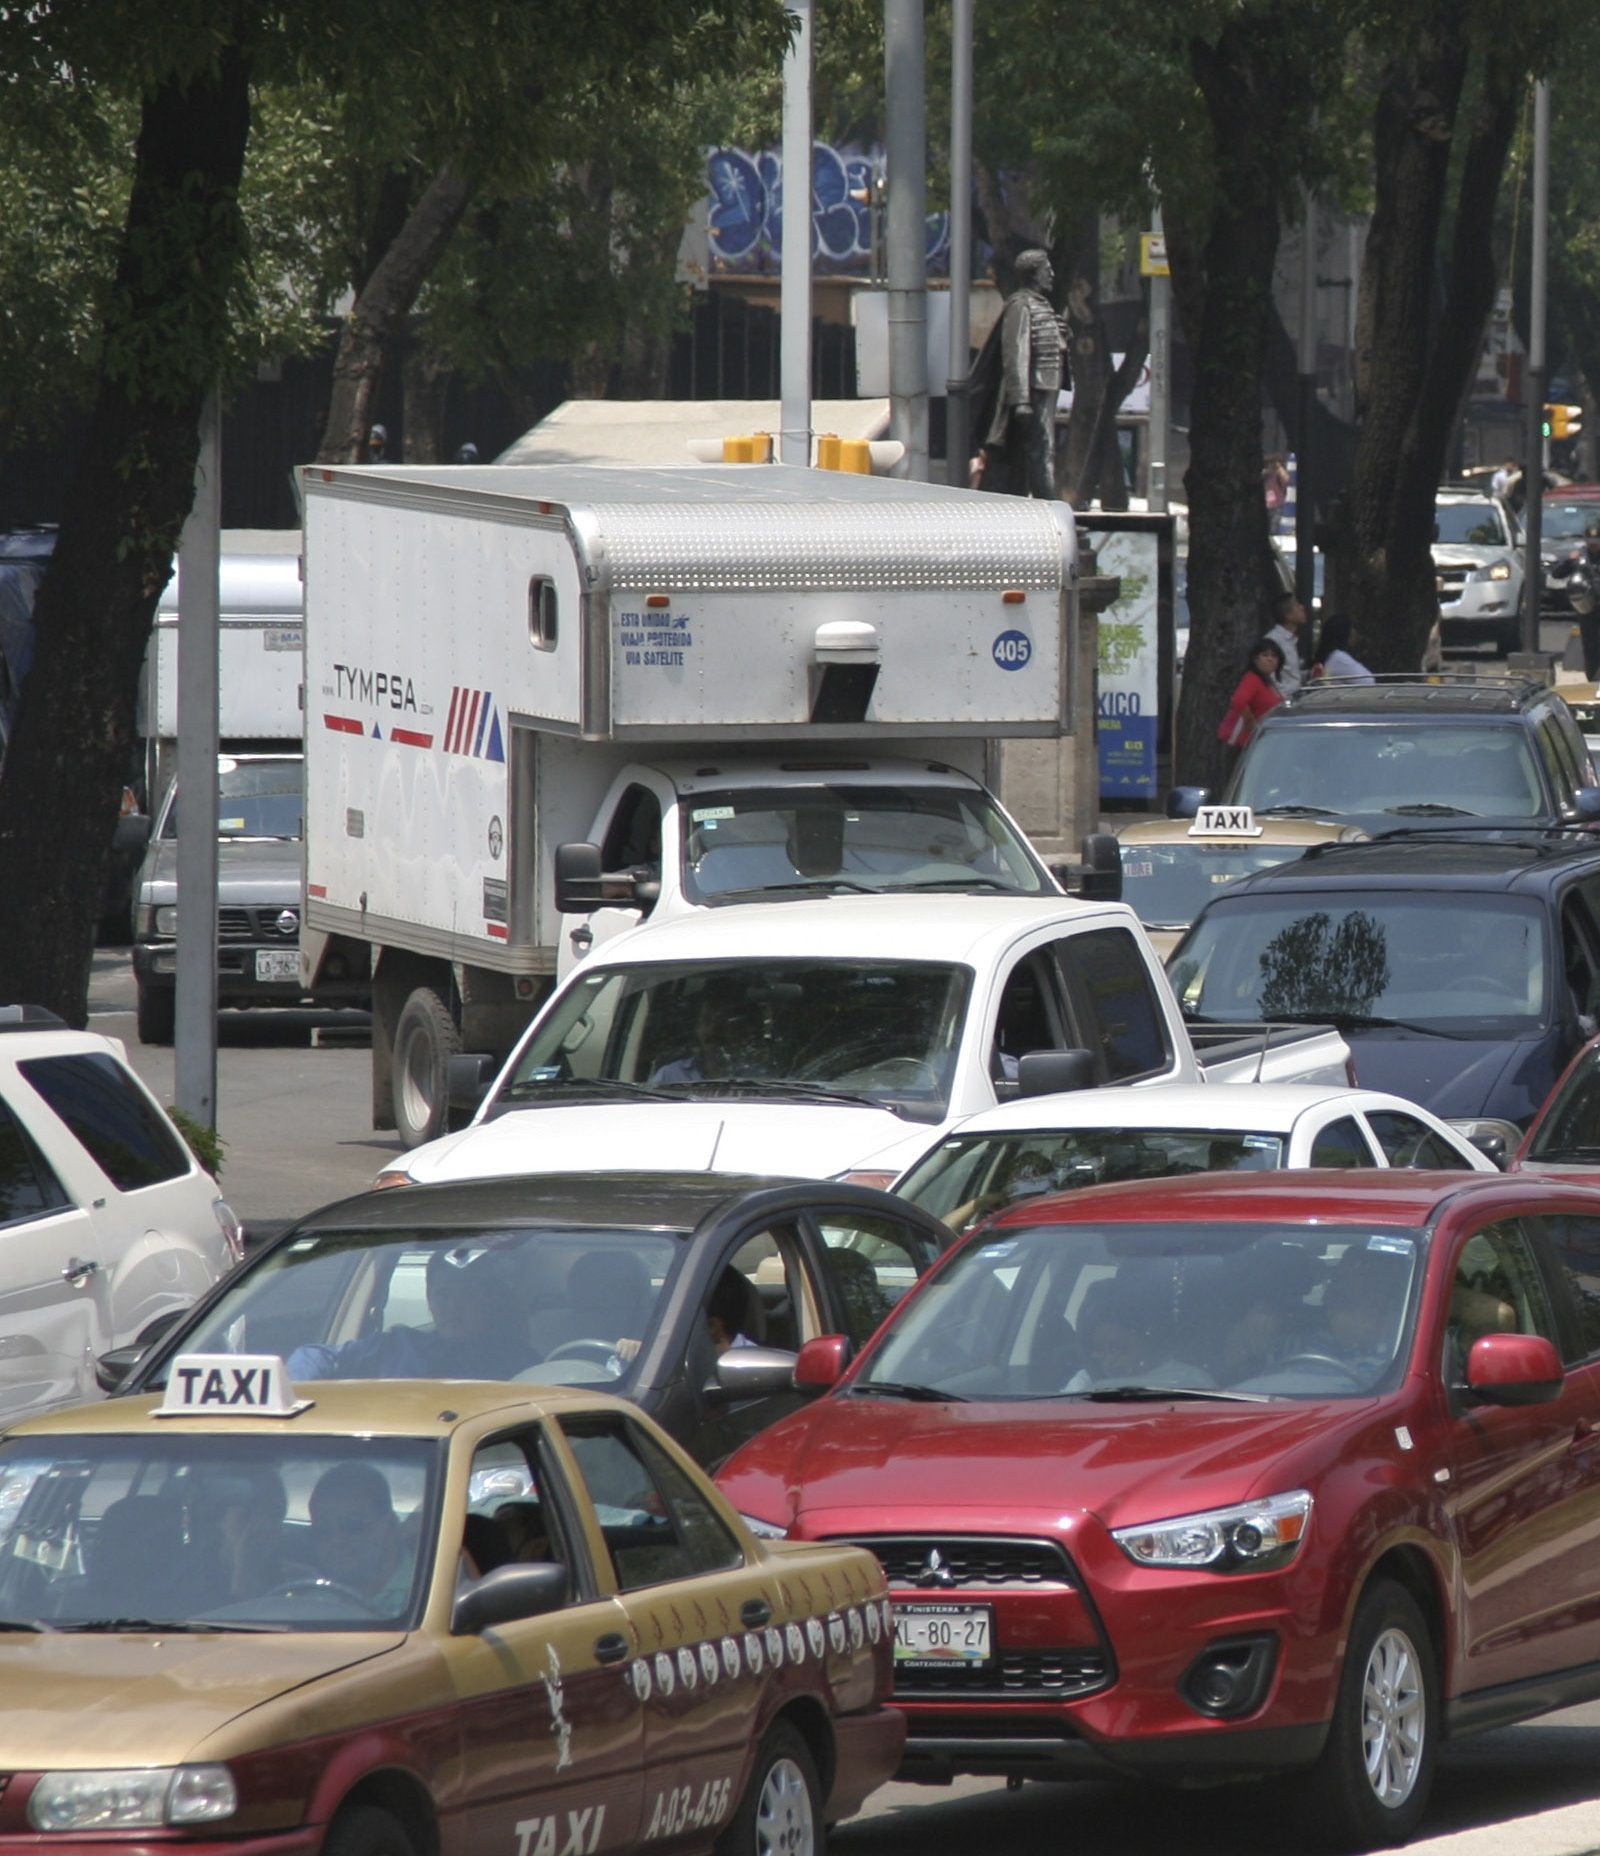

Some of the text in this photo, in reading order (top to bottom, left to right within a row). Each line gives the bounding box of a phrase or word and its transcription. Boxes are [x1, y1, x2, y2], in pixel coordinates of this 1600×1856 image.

[621, 613, 670, 627] ESTA UNIDAD
[620, 632, 692, 646] VIAJA PROTEGIDA
[626, 652, 683, 665] VIA SATELITE
[994, 640, 1029, 661] 405
[334, 664, 417, 713] TYMPSA
[1203, 811, 1248, 829] TAXI
[178, 1367, 271, 1405] TAXI
[907, 1605, 959, 1613] FINISTERRA
[645, 1777, 732, 1841] A-03-456
[514, 1804, 606, 1856] TAXI
